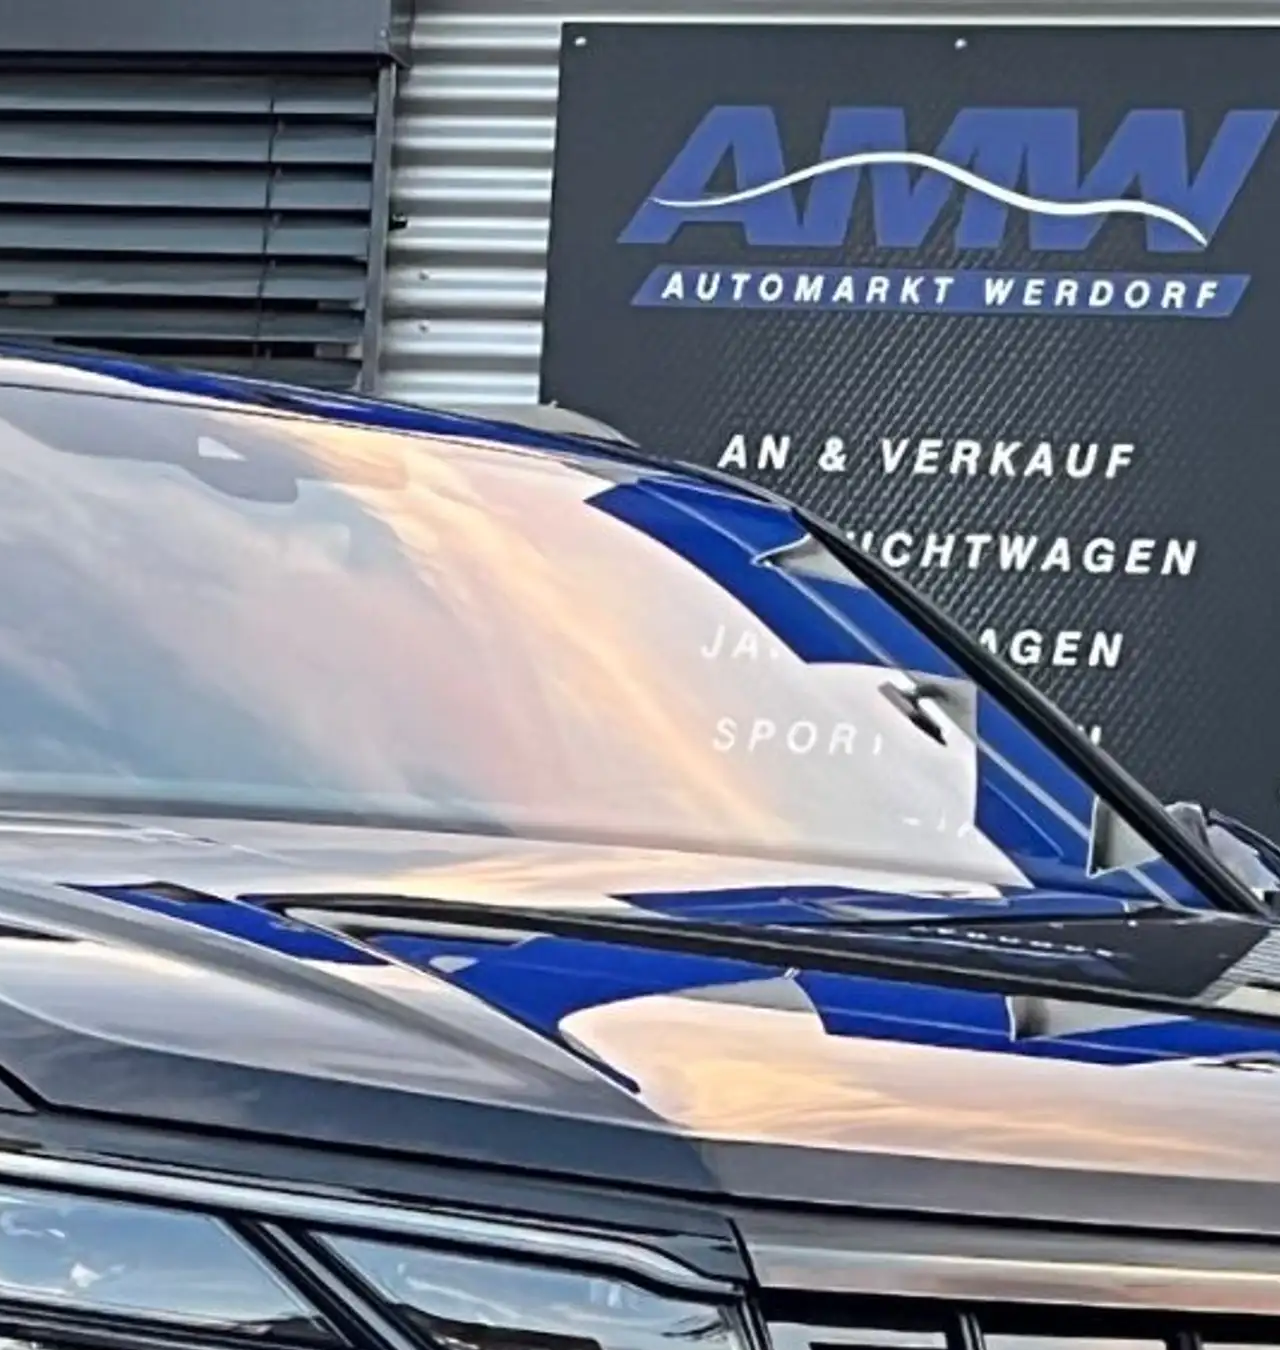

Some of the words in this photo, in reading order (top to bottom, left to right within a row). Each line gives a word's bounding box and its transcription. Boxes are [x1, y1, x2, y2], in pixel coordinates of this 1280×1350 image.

[661, 271, 957, 304] AUTOMARKT
[983, 277, 1219, 309] WERDORF
[717, 433, 791, 470] AN
[818, 436, 848, 473] &
[880, 438, 1135, 478] VERKAUF
